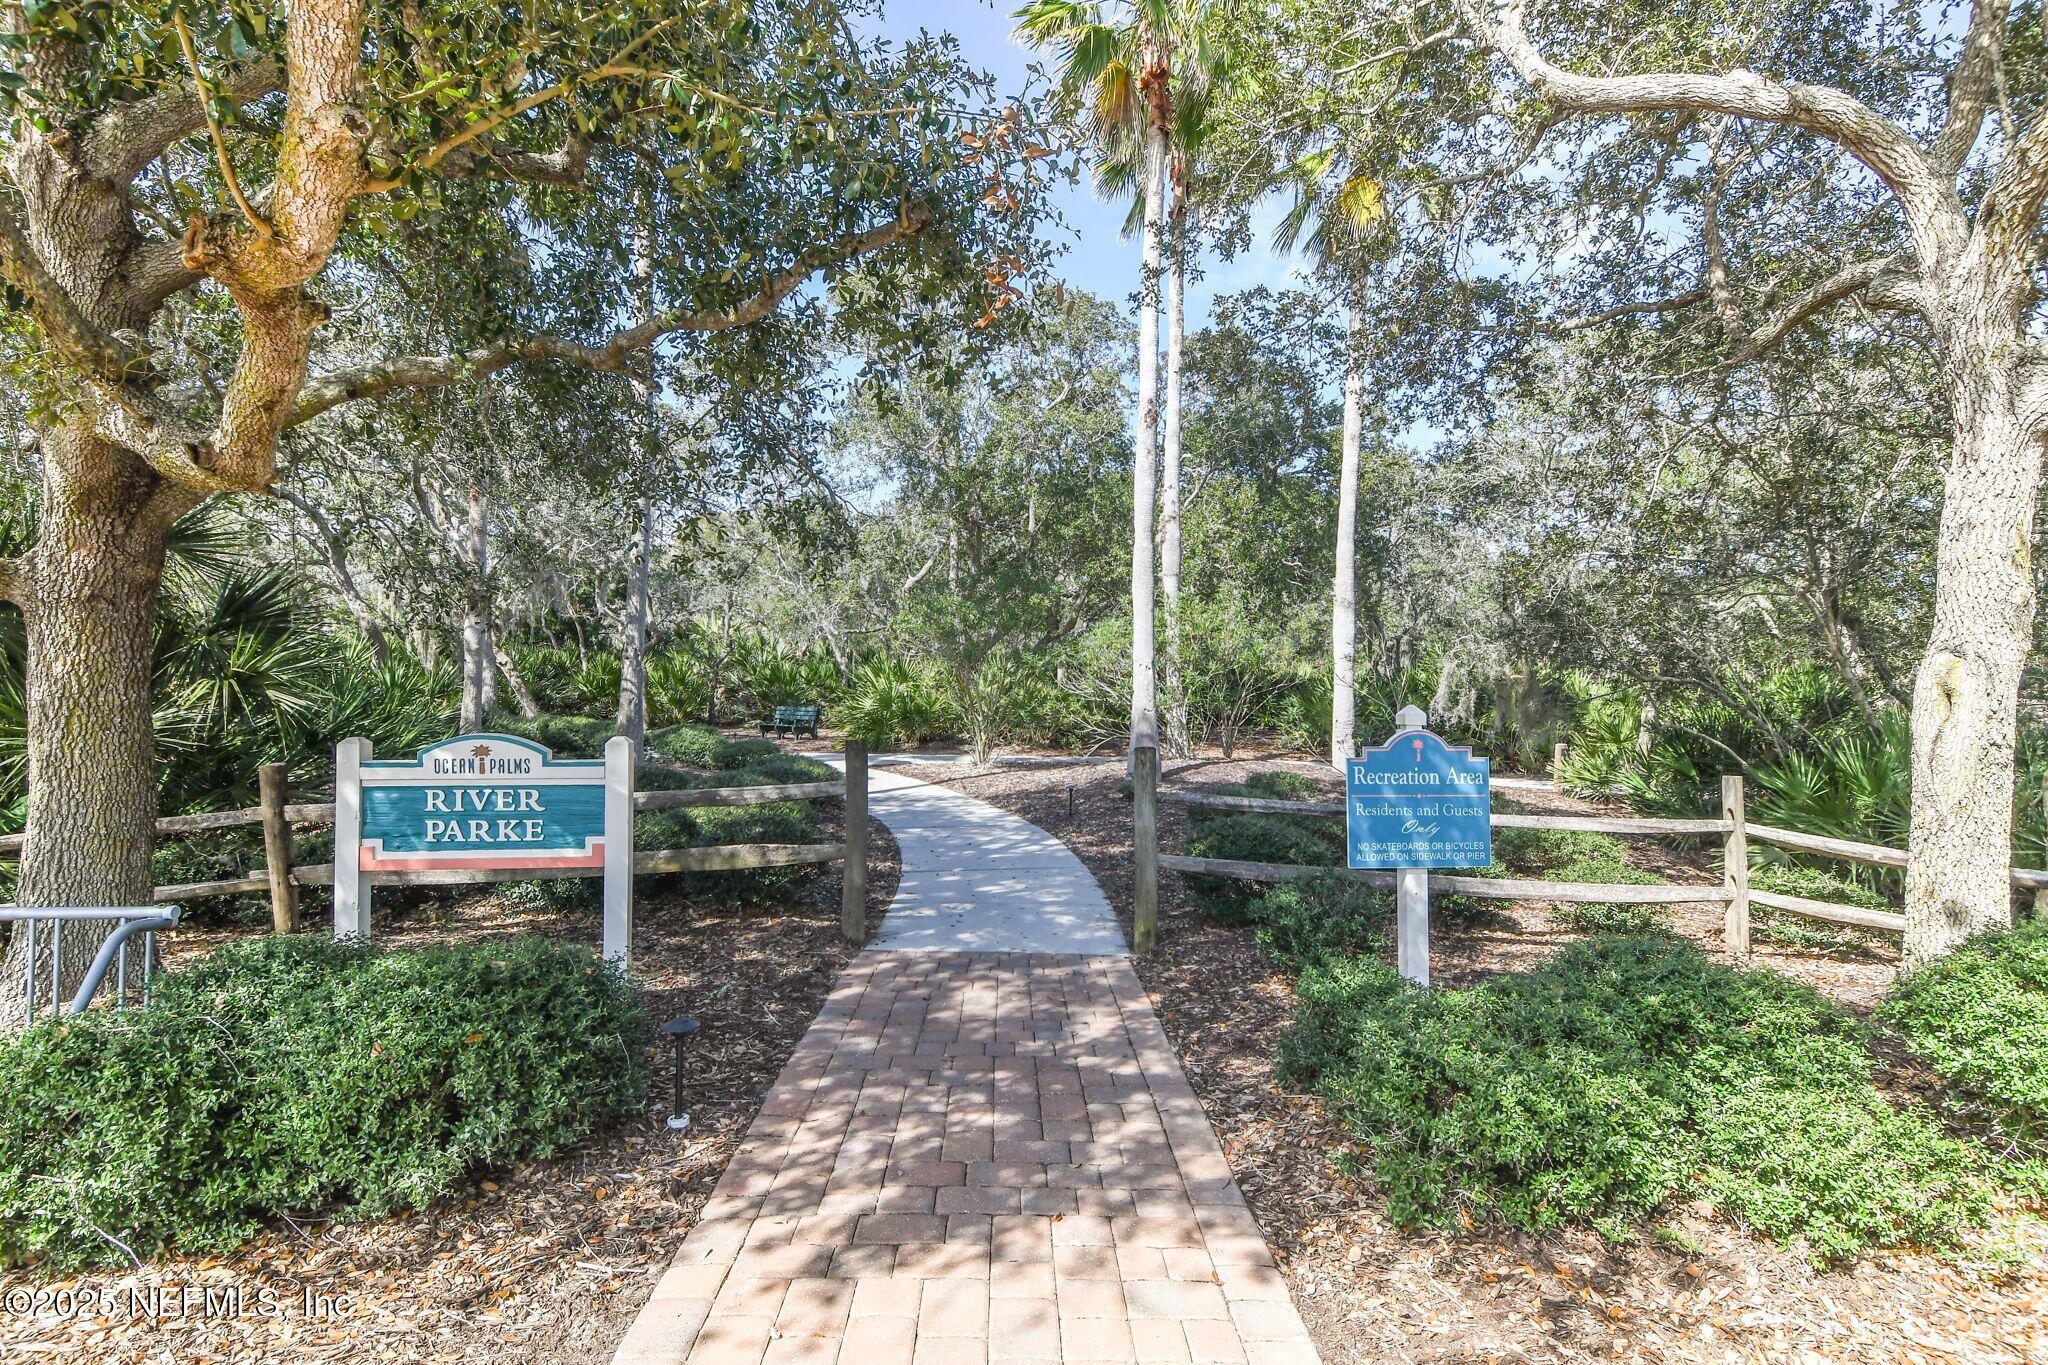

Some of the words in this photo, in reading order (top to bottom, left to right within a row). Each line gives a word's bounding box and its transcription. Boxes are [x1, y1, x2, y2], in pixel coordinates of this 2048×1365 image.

[434, 758, 474, 774] OCEAN
[489, 758, 531, 774] PALMS
[1353, 766, 1440, 785] Recreation
[1446, 766, 1484, 785] Area
[424, 789, 546, 812] RIVER
[1356, 803, 1413, 816] Residents
[1417, 803, 1439, 816] and
[1443, 803, 1483, 816] Guests
[424, 819, 546, 843] PARKE
[1401, 819, 1441, 837] Only
[1357, 843, 1370, 851] NO
[1371, 842, 1430, 850] SKATEBOARDS
[1431, 842, 1444, 850] OR
[1445, 841, 1485, 850] BICYCLES
[1356, 853, 1396, 861] ALLOWED
[1398, 853, 1409, 861] ON
[1411, 852, 1451, 860] SIDEWALK
[1453, 852, 1465, 860] OR
[1467, 852, 1486, 860] PIER
